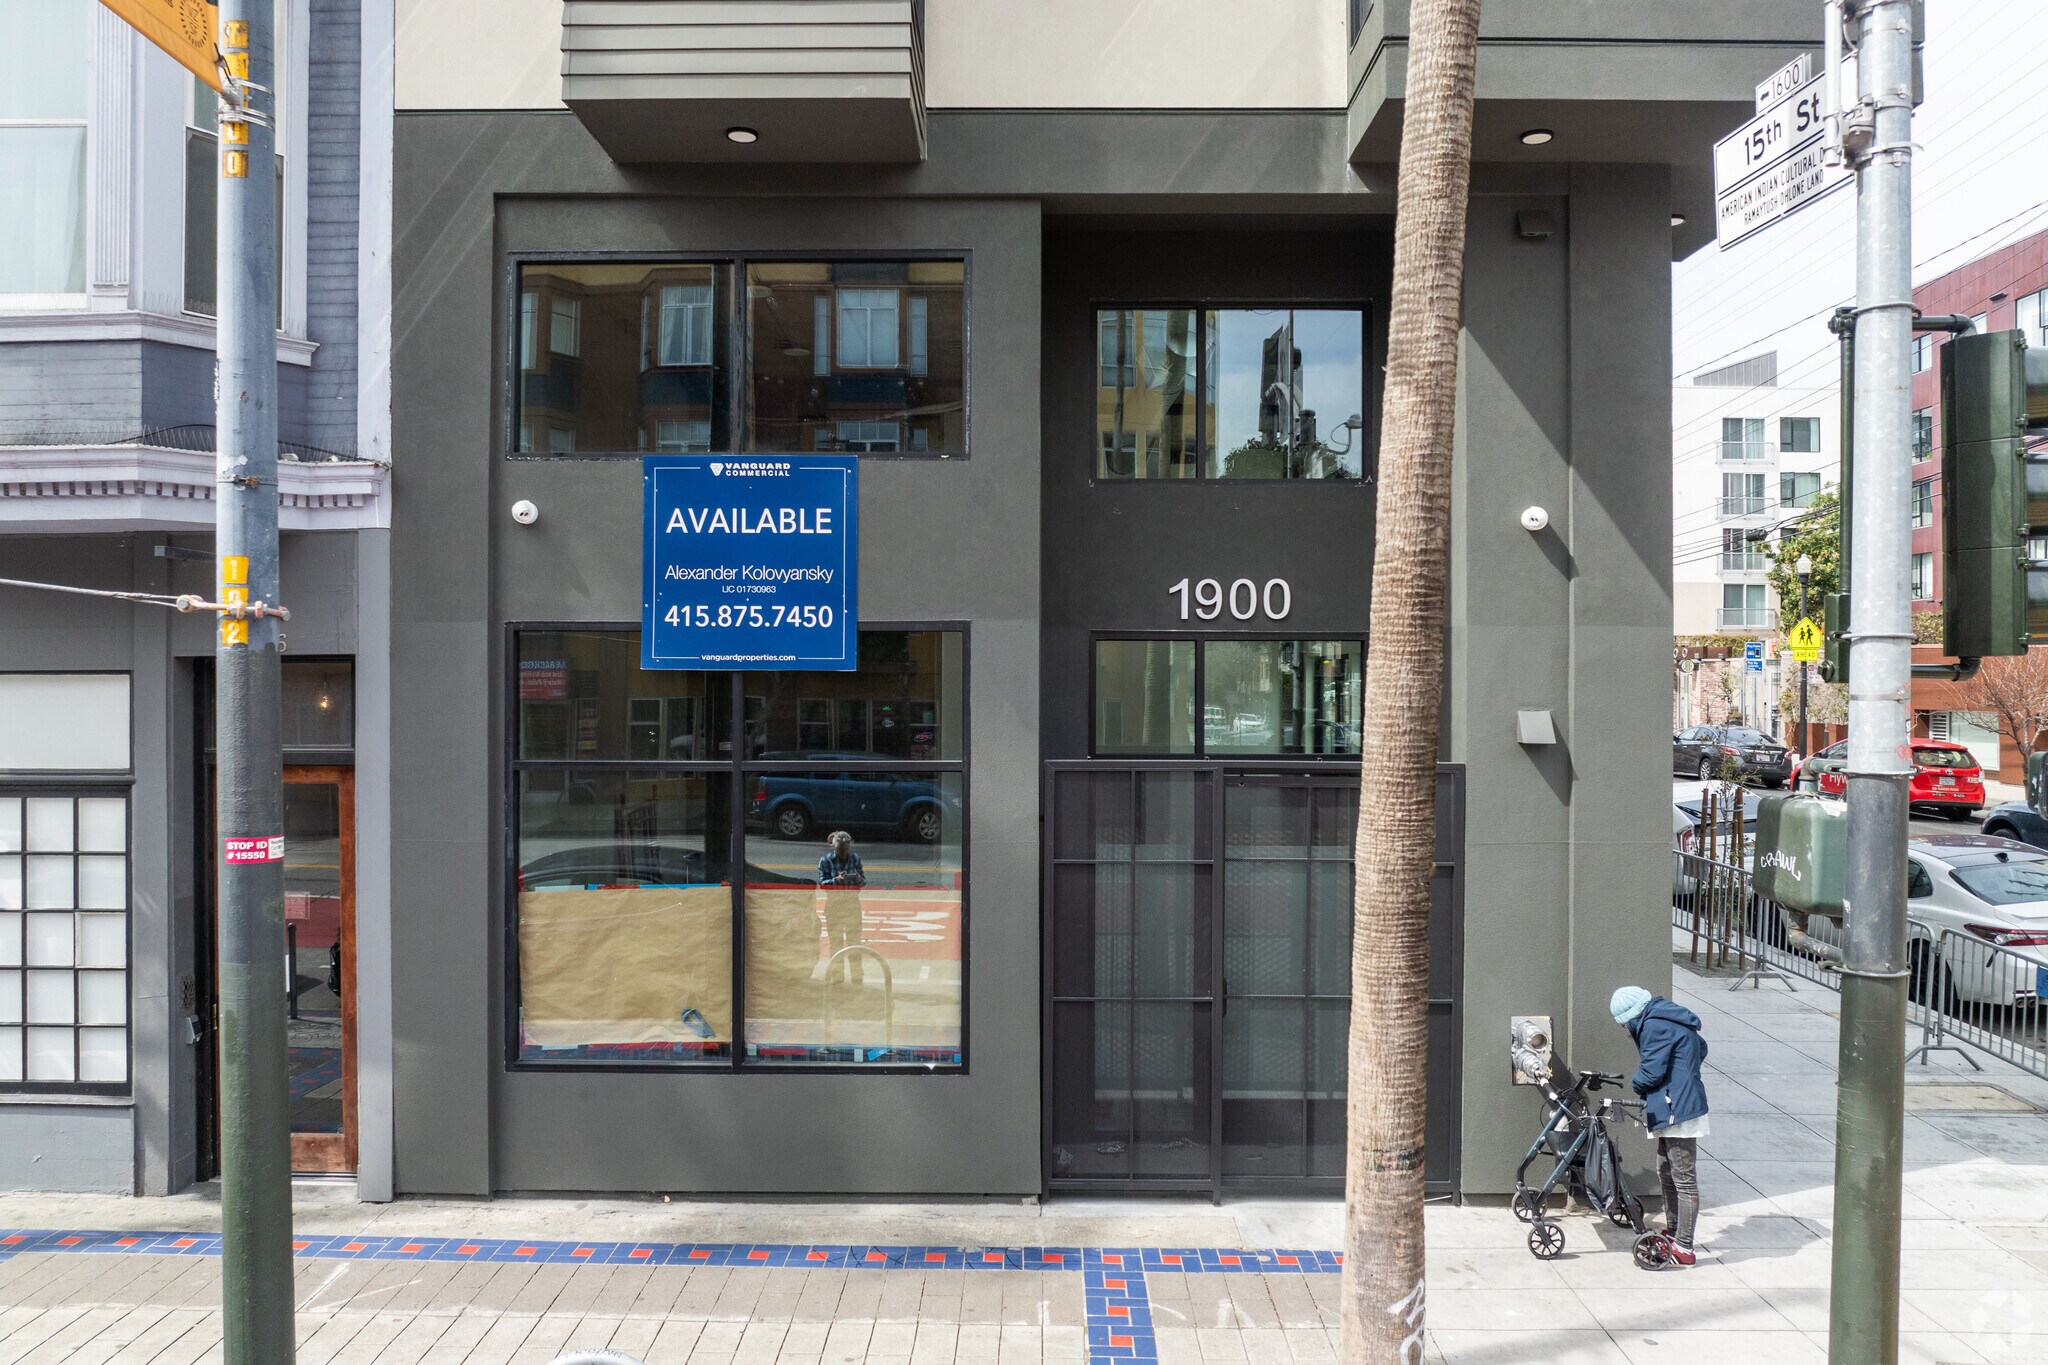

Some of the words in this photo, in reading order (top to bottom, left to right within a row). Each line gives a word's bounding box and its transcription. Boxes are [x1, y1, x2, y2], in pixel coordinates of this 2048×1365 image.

[1772, 63, 1800, 100] 1600
[1744, 119, 1782, 166] 15th
[1796, 91, 1820, 132] St
[1721, 190, 1752, 221] AMERICAN
[1755, 174, 1778, 201] INDIAN
[1781, 152, 1817, 186] CULTURAL
[1744, 196, 1778, 226] RAMAYTUSH
[1781, 180, 1805, 206] OHLONE
[1807, 169, 1824, 191] LAND
[725, 462, 791, 470] VANGUARD
[666, 508, 833, 534] AVAILABLE
[664, 565, 738, 581] Alexander
[742, 565, 834, 584] Kolovyansky
[722, 585, 735, 593] LIC
[736, 585, 776, 593] 01730963
[1168, 578, 1291, 620] 1900
[664, 605, 833, 628] 415.875.7450
[701, 654, 796, 662] vanguardproperties.com
[226, 841, 254, 850] STOP
[256, 841, 268, 850] ID
